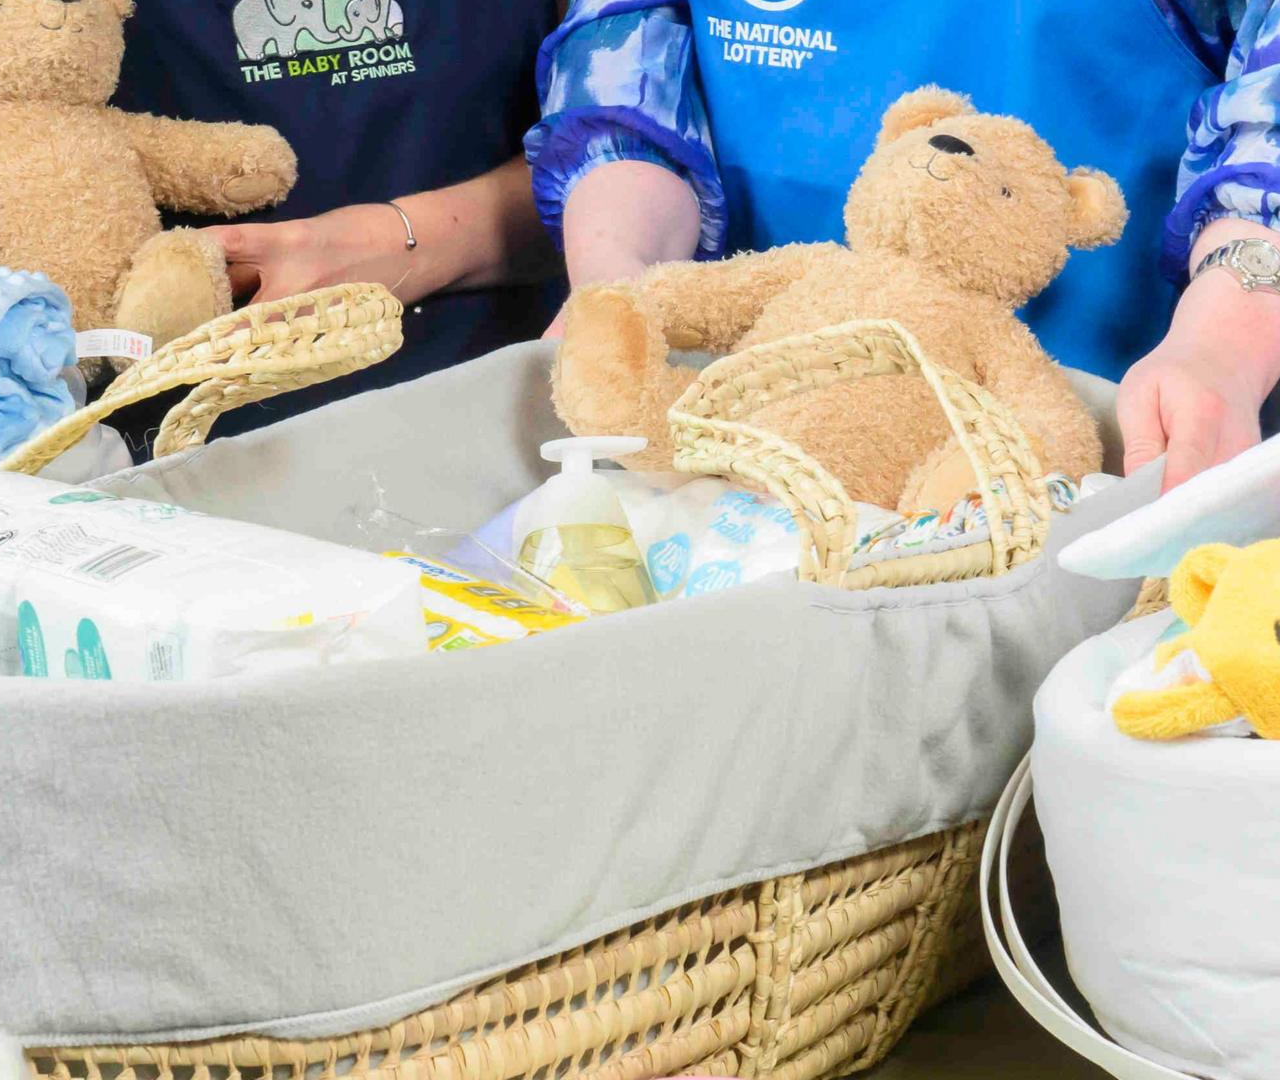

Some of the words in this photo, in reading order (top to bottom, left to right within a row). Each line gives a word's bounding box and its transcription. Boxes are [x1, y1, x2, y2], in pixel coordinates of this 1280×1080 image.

[707, 16, 732, 40] THE
[735, 21, 838, 52] NATIONAL
[241, 62, 283, 83] THE
[287, 53, 342, 76] BABY
[348, 42, 412, 67] ROOM
[331, 72, 348, 86] AT
[352, 60, 416, 82] SPINNERS
